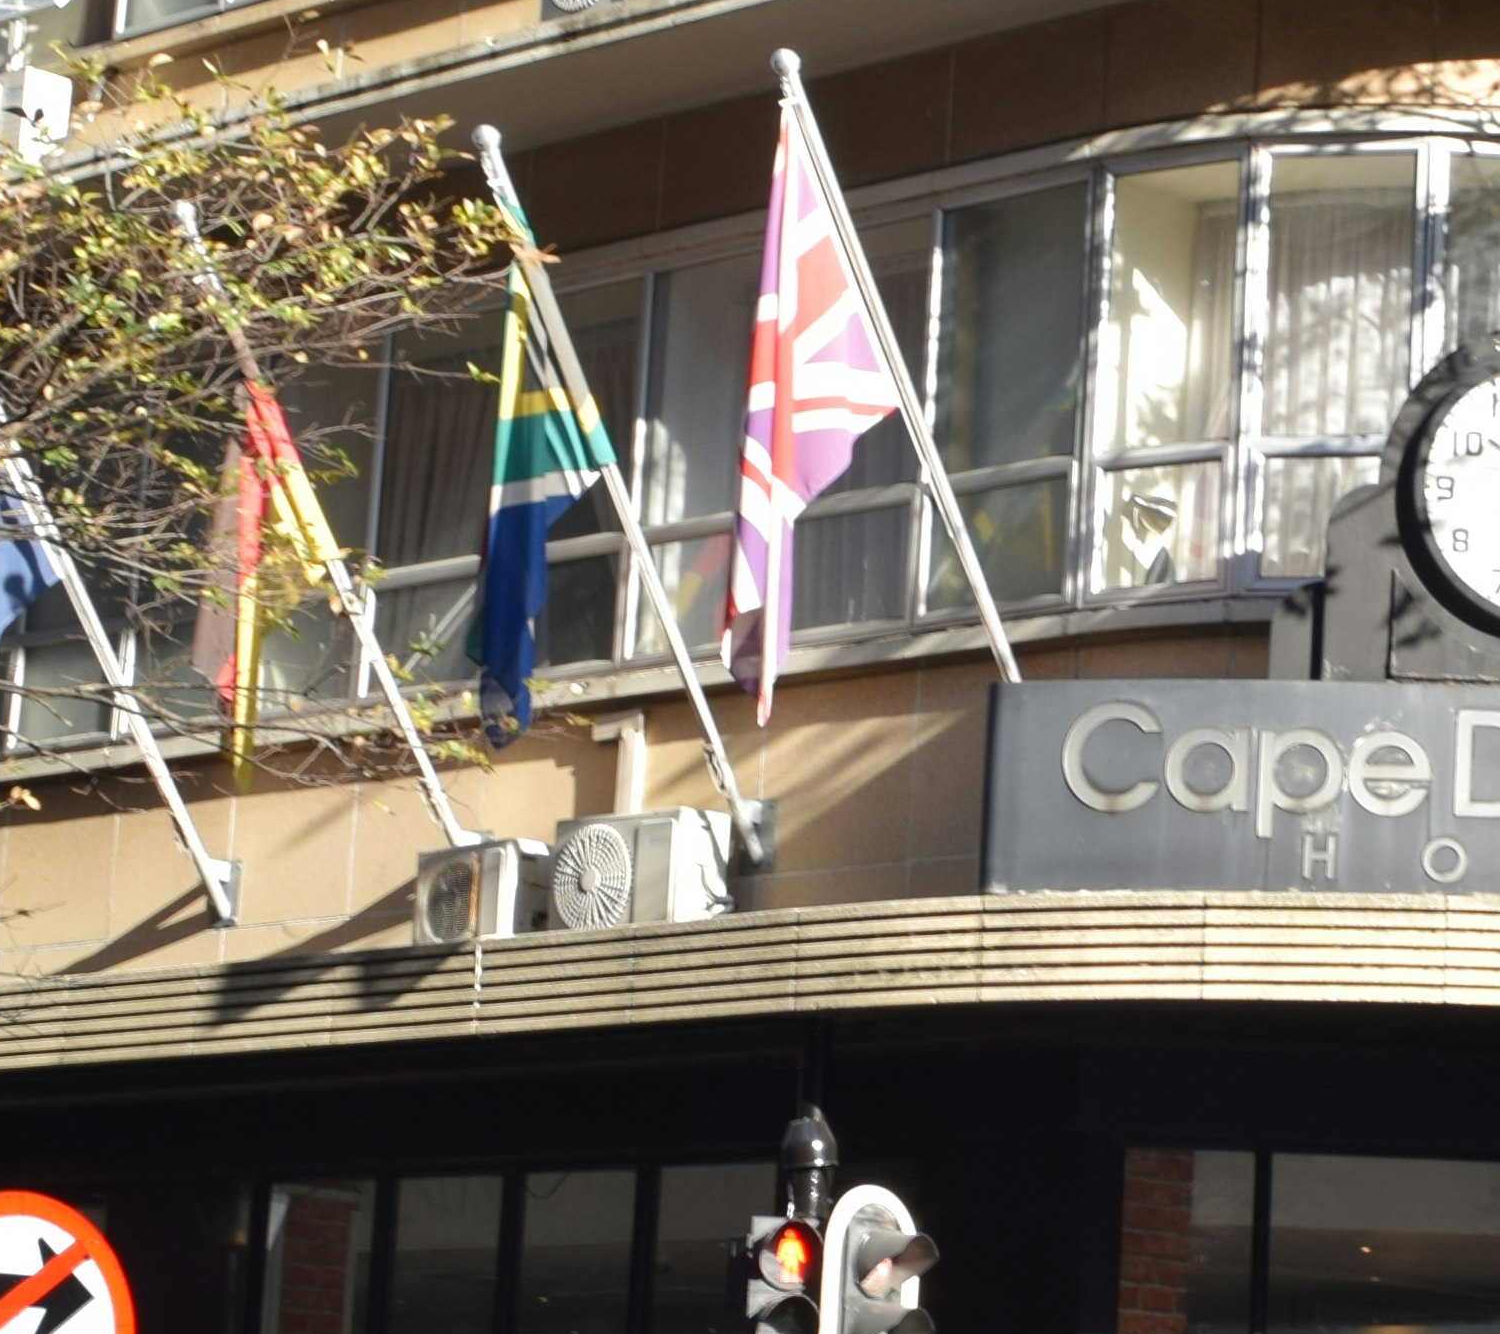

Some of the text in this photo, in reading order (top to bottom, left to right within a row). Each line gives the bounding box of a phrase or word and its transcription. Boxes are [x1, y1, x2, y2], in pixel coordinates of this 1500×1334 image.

[1453, 431, 1483, 457] 10
[1436, 475, 1455, 501] 9
[1452, 528, 1470, 553] 8
[1060, 701, 1433, 838] Cape
